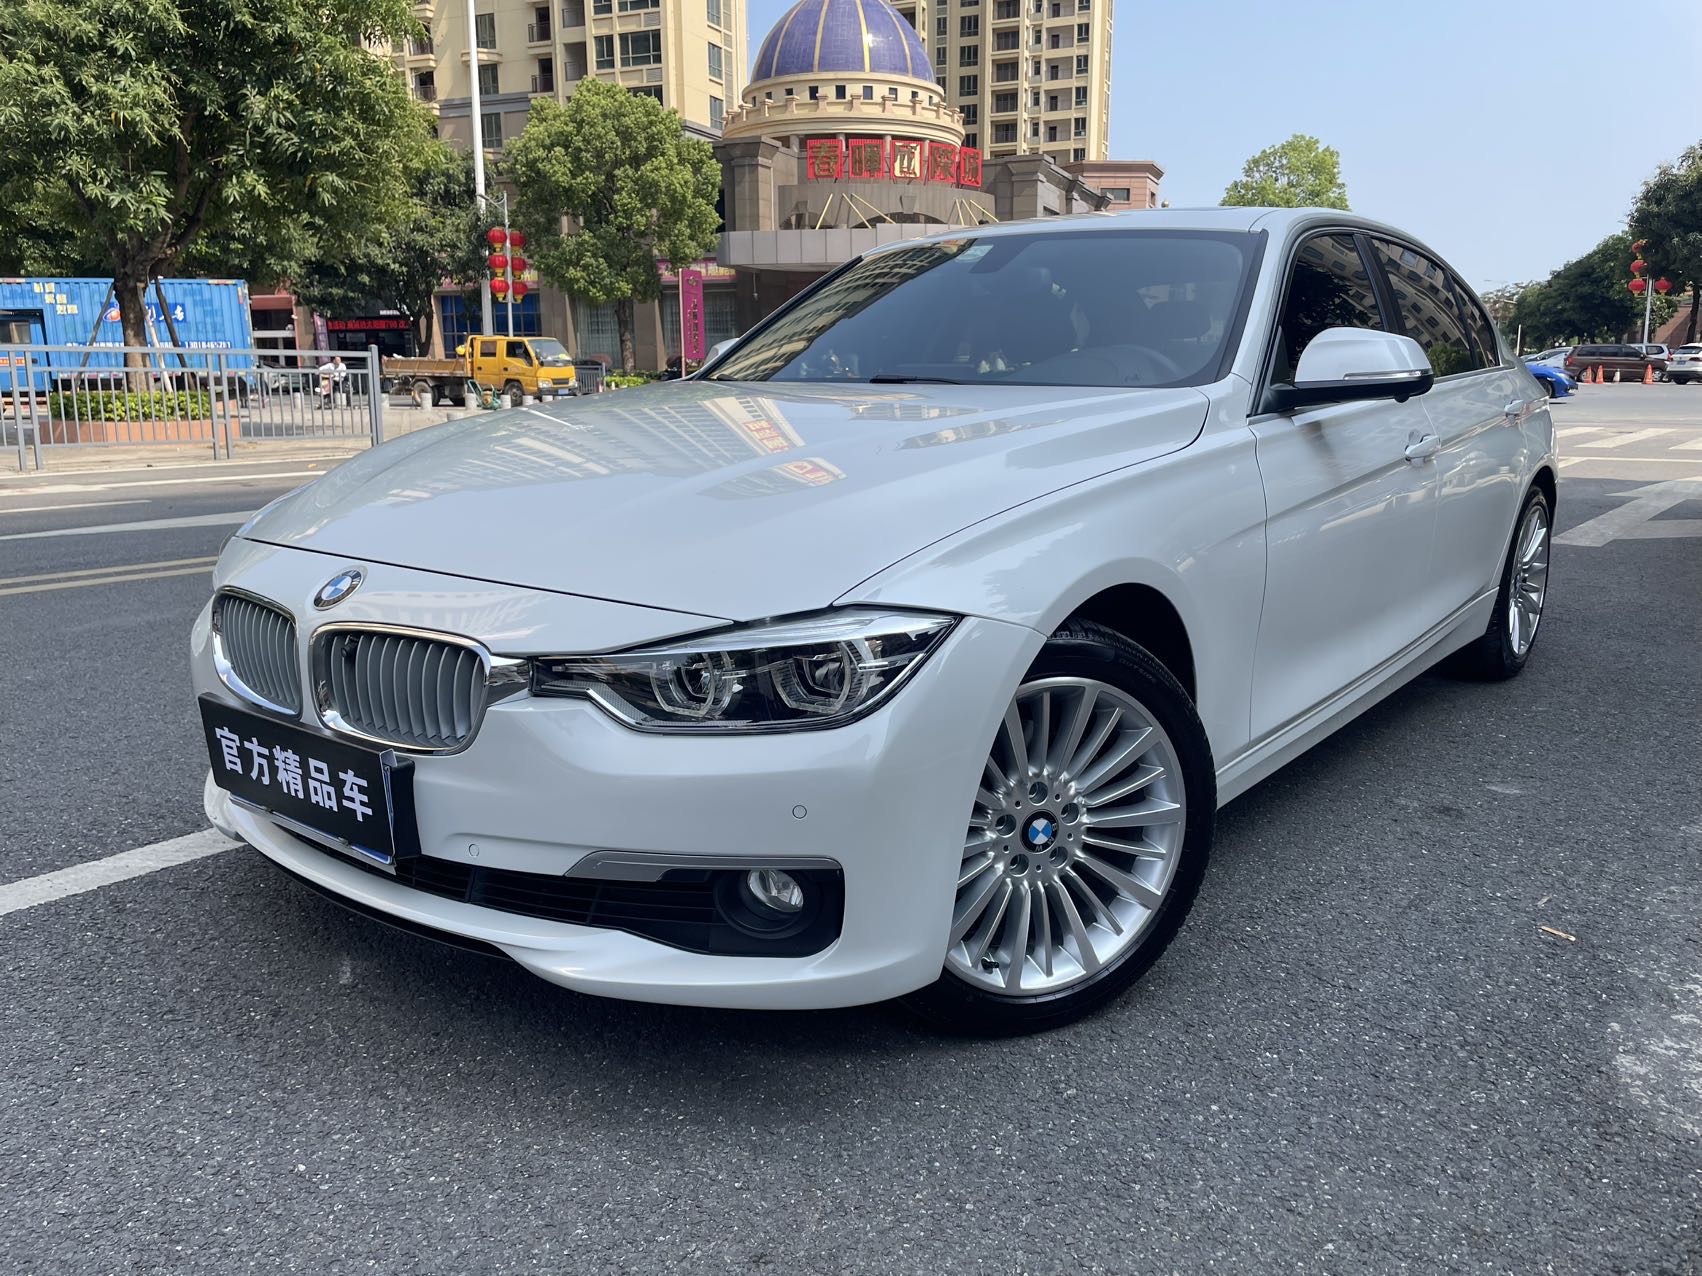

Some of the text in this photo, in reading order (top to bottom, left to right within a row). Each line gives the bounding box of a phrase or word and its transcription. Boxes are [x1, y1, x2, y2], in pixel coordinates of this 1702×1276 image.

[215, 726, 373, 823] 官方精品车
